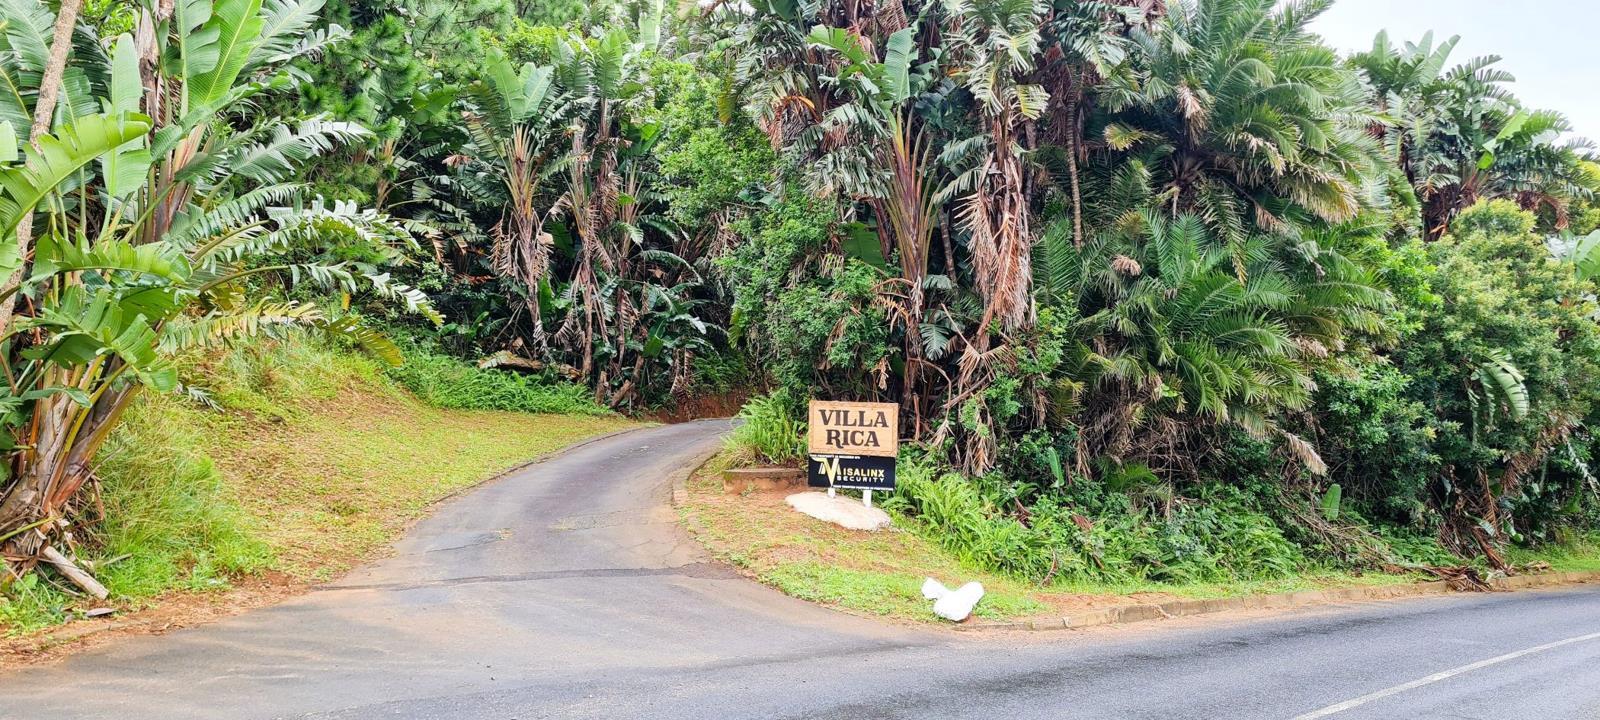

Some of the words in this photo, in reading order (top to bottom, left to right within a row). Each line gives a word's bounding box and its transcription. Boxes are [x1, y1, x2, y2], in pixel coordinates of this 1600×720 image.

[818, 409, 889, 428] VILLA
[825, 429, 880, 449] RICA
[836, 475, 885, 483] SECURITY
